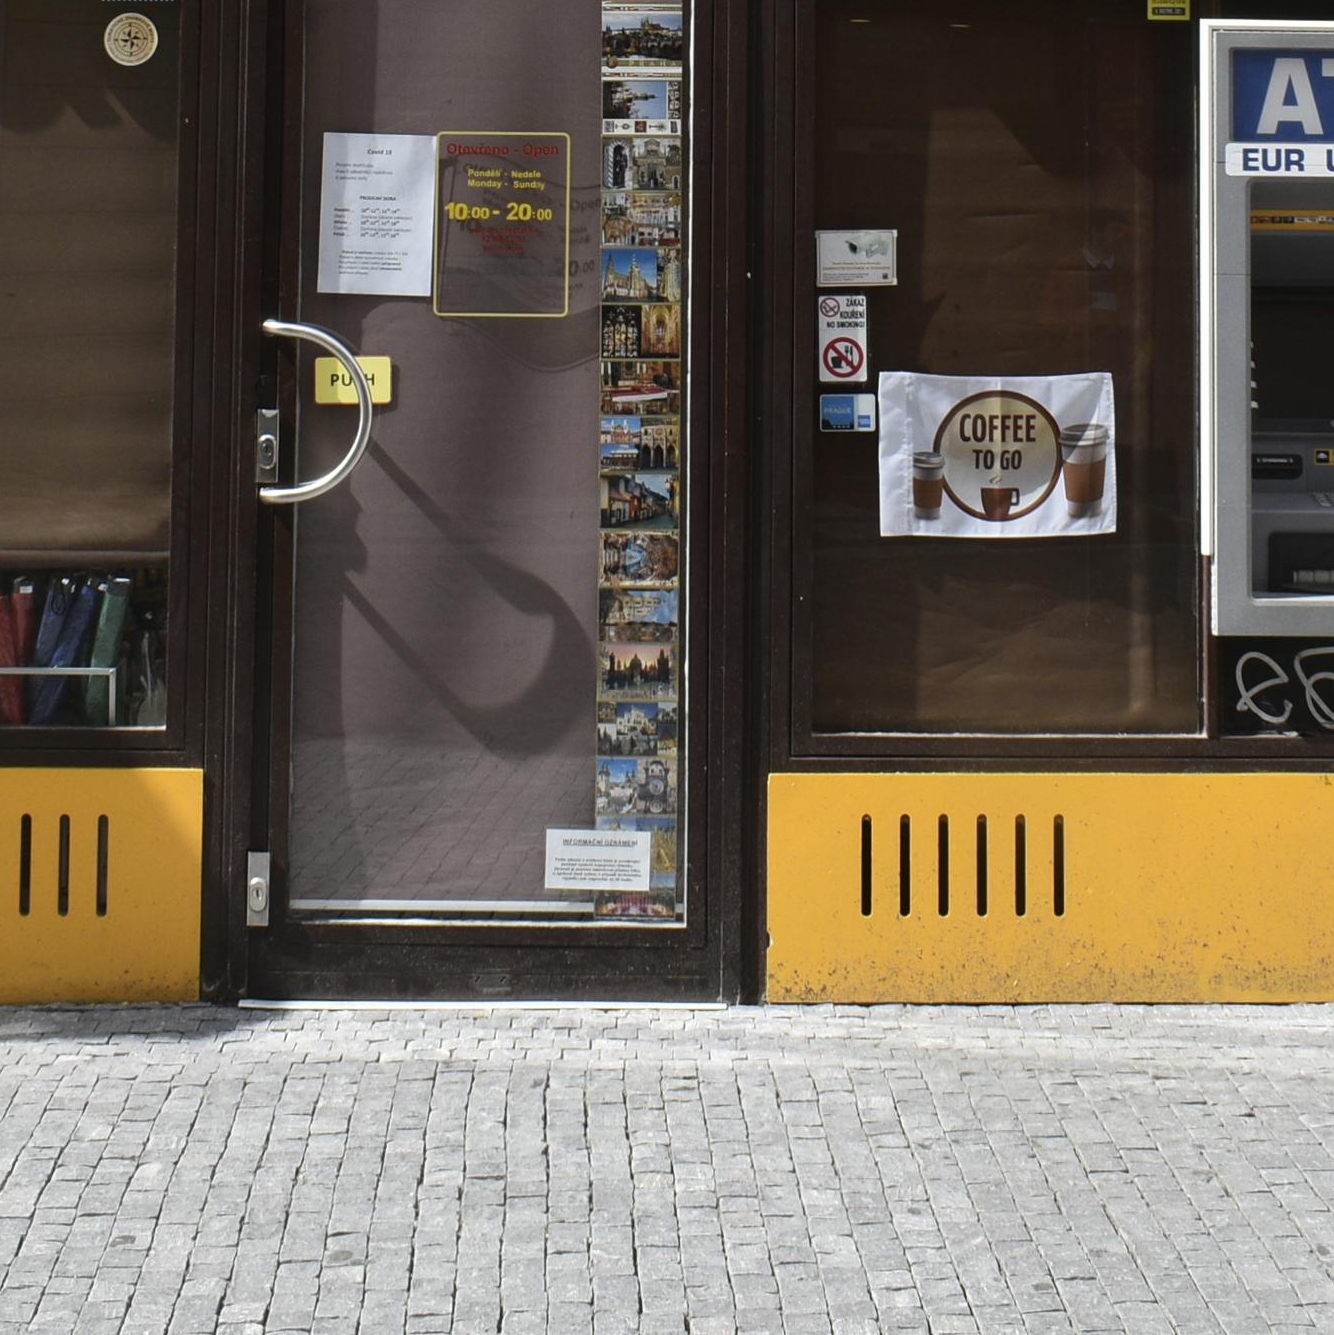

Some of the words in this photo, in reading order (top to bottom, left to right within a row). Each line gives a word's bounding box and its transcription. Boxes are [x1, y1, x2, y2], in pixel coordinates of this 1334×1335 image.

[523, 143, 559, 158] Open
[1242, 148, 1305, 172] EUR
[467, 179, 502, 189] Monday
[513, 181, 545, 191] Sunday
[444, 202, 490, 220] 10:00
[507, 202, 553, 221] 20:00
[330, 373, 375, 387] PUH
[959, 413, 1036, 443] COFFEE
[972, 449, 995, 470] TO
[1000, 449, 1022, 470] GO
